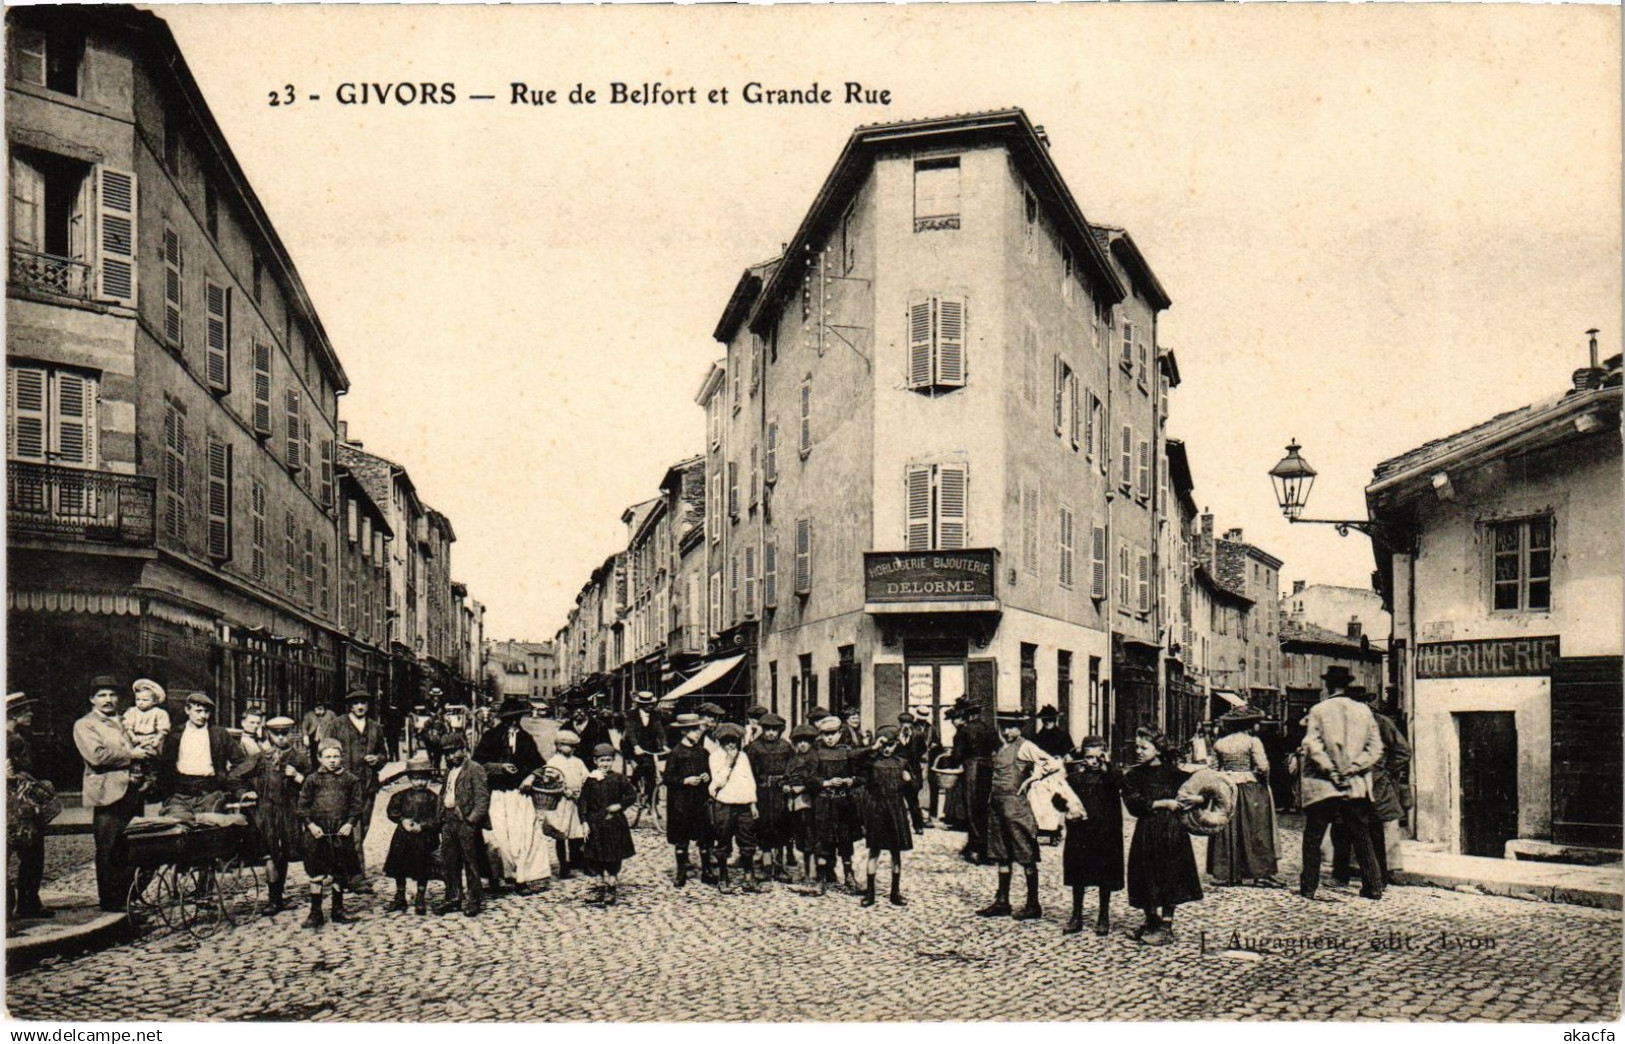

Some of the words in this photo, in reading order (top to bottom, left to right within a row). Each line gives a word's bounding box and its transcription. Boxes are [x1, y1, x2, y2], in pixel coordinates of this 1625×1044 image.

[869, 557, 926, 578] HORLOGERIE
[933, 557, 989, 575] BIJOUTERIE
[887, 581, 974, 594] DELORME
[1418, 641, 1555, 672] IMPRIMERIE
